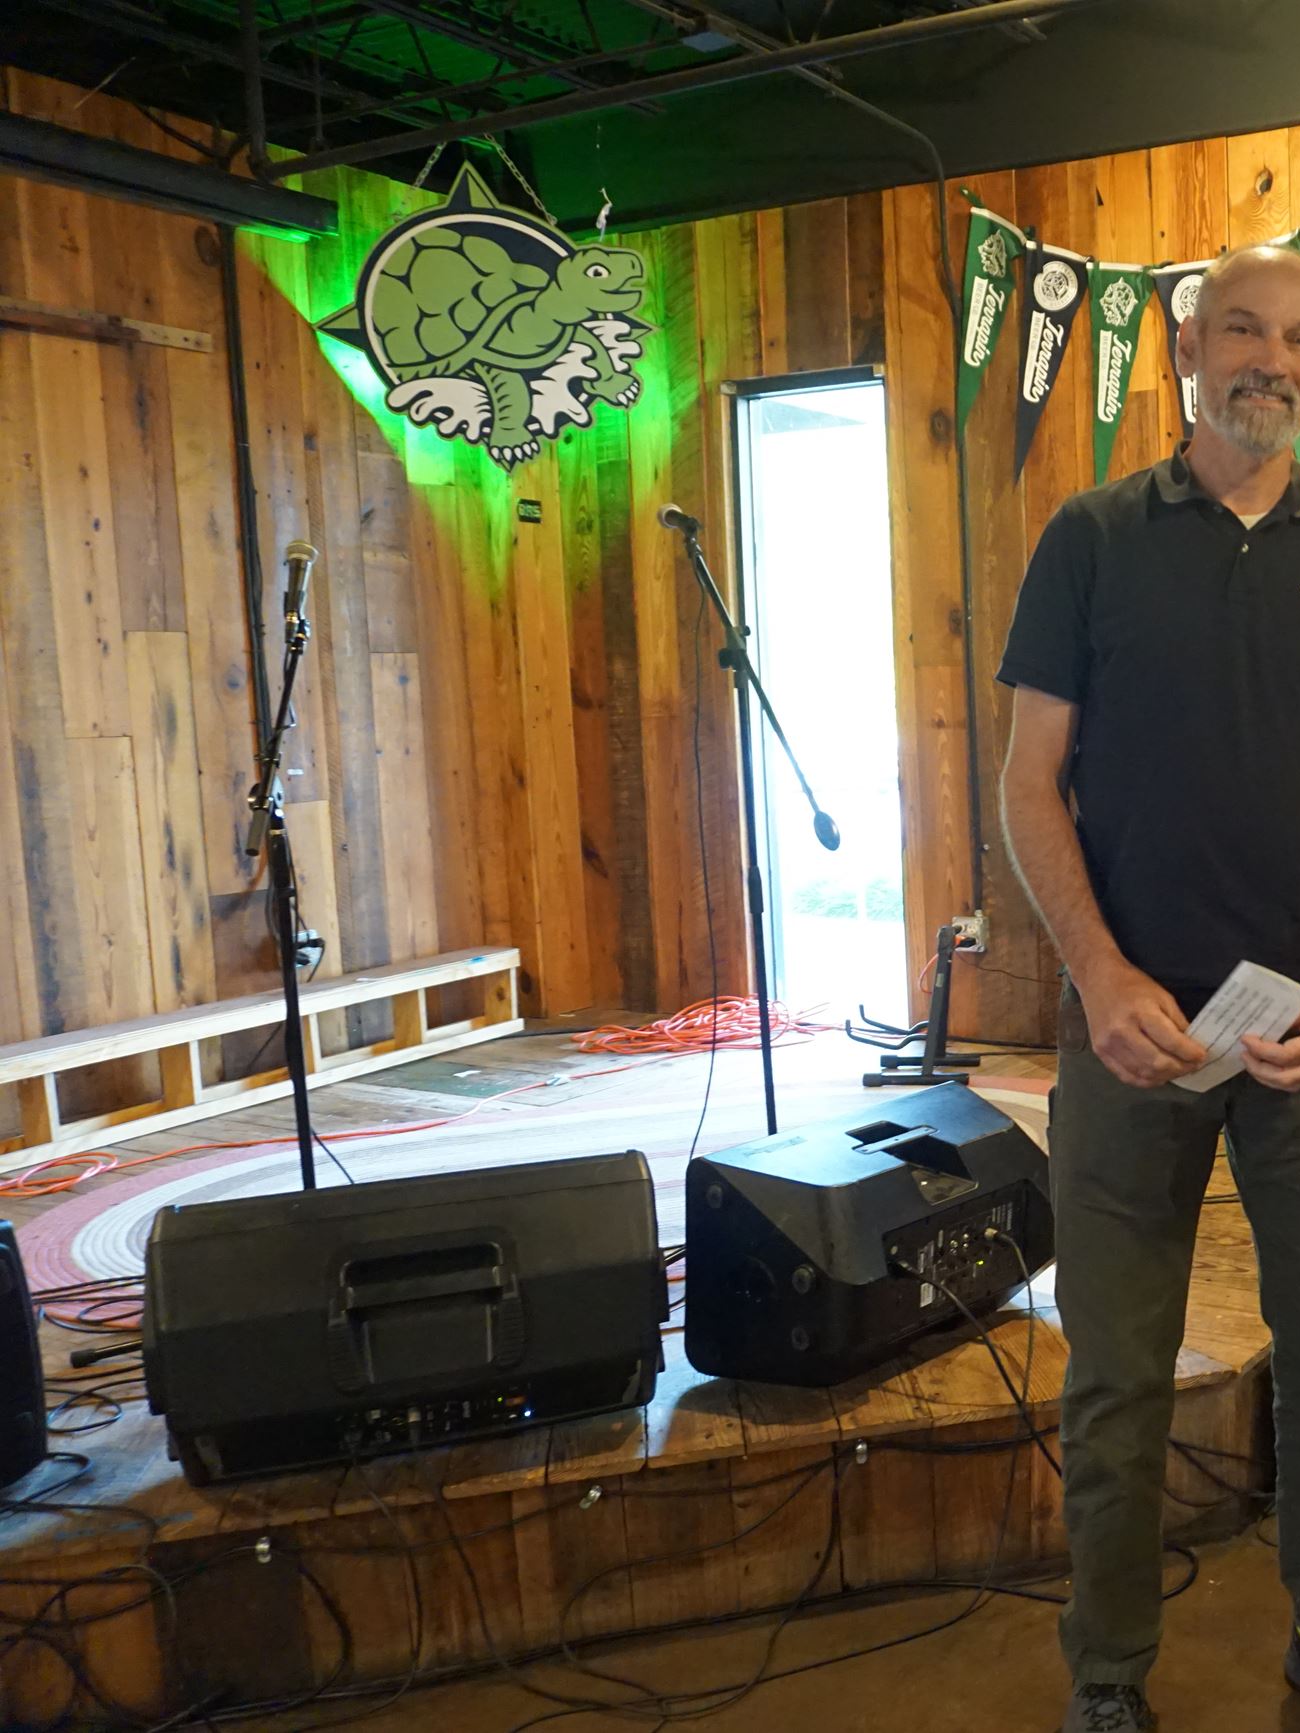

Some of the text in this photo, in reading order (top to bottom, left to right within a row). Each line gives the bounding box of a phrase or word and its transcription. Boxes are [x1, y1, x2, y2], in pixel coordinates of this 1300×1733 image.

[971, 283, 1005, 367] Terrapin
[1030, 317, 1064, 402] Terrapin
[1105, 334, 1132, 422] Terrapin
